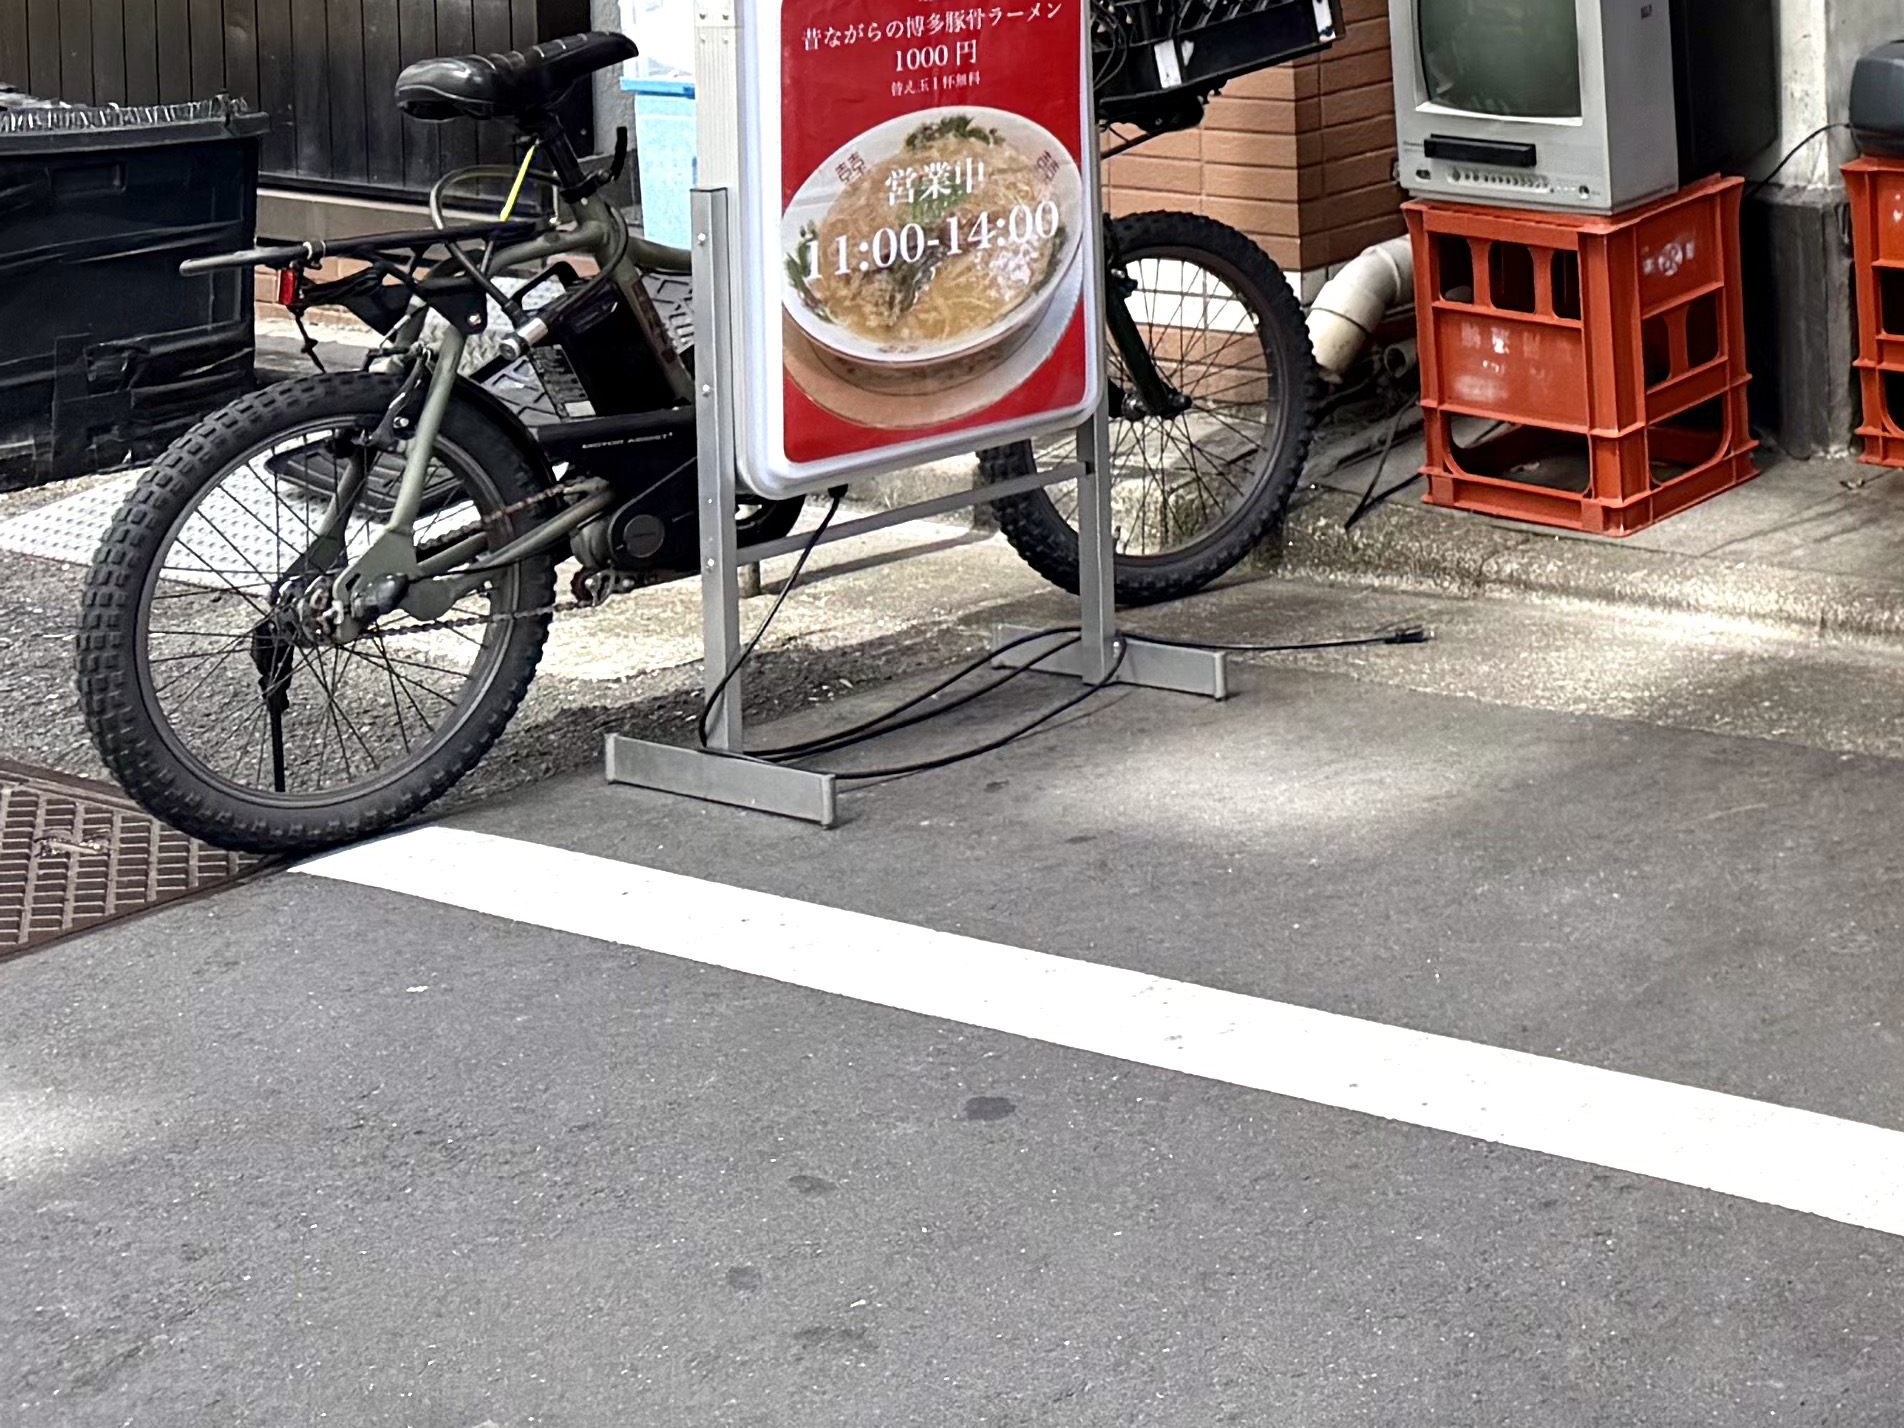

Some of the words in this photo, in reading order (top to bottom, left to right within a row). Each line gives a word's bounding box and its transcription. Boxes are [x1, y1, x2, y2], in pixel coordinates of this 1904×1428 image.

[802, 1, 1062, 51] 昔ながらの博多豚骨ラーメン
[884, 154, 985, 208] 営業中
[804, 198, 1061, 282] 11:00-14:00
